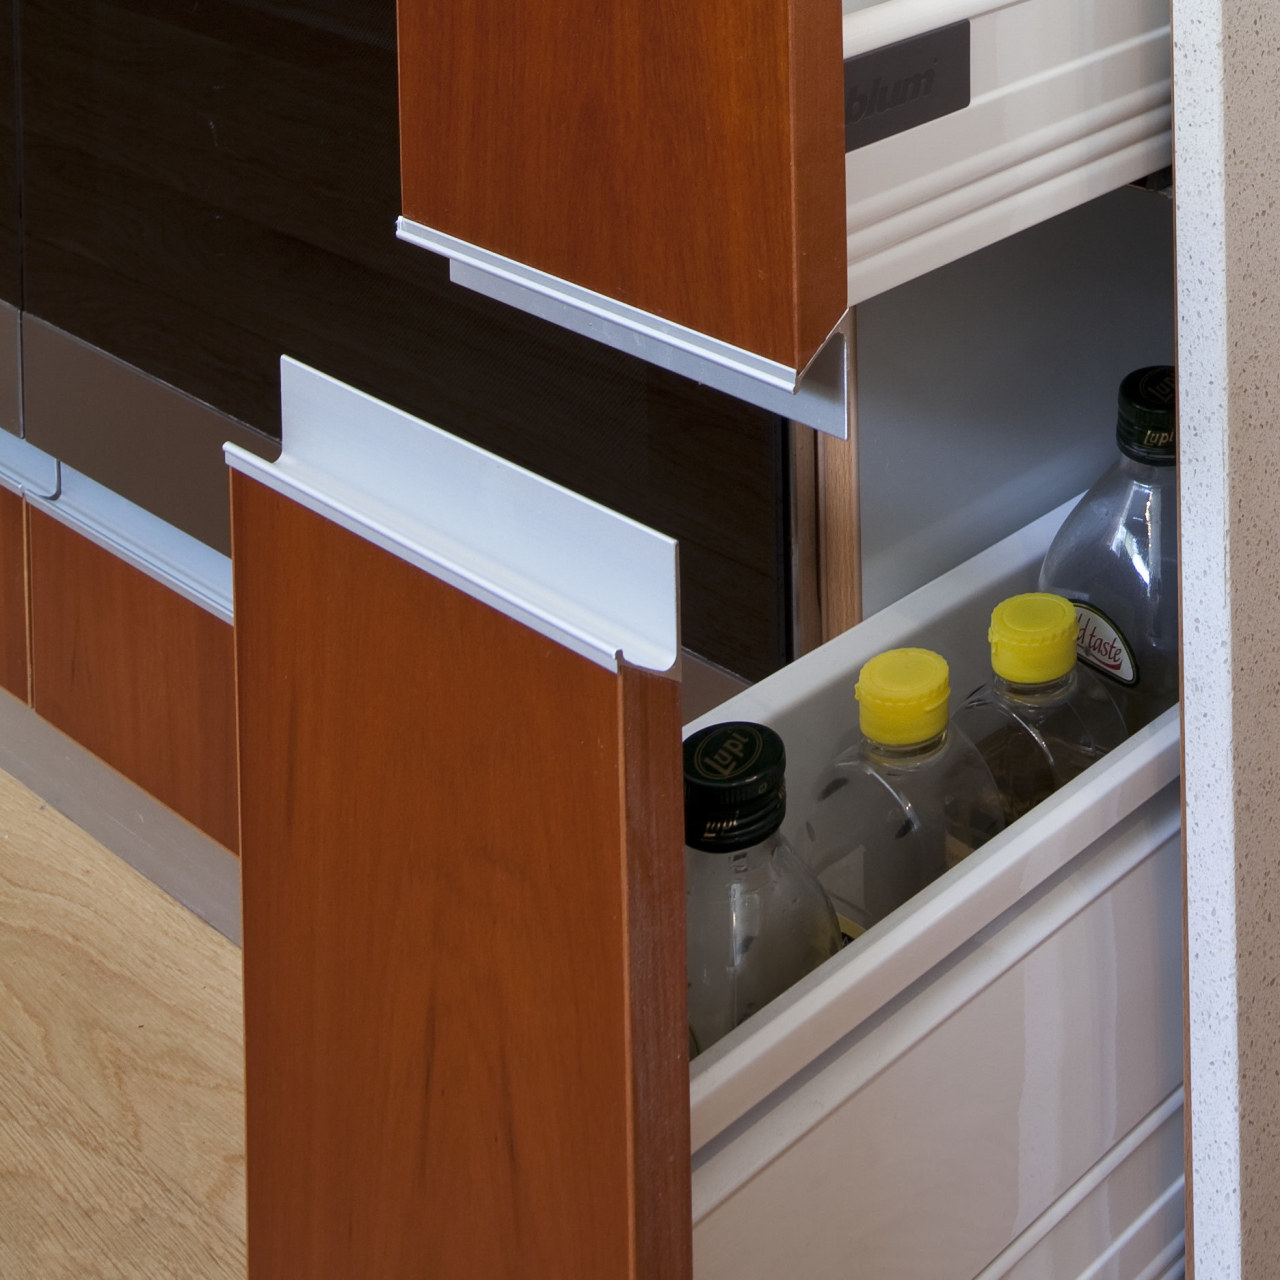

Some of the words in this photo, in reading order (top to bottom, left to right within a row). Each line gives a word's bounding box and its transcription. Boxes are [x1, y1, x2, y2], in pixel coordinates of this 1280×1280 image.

[845, 69, 936, 125] blum
[1143, 429, 1174, 448] Lupi
[1088, 626, 1122, 663] taste
[703, 732, 750, 776] Lupi
